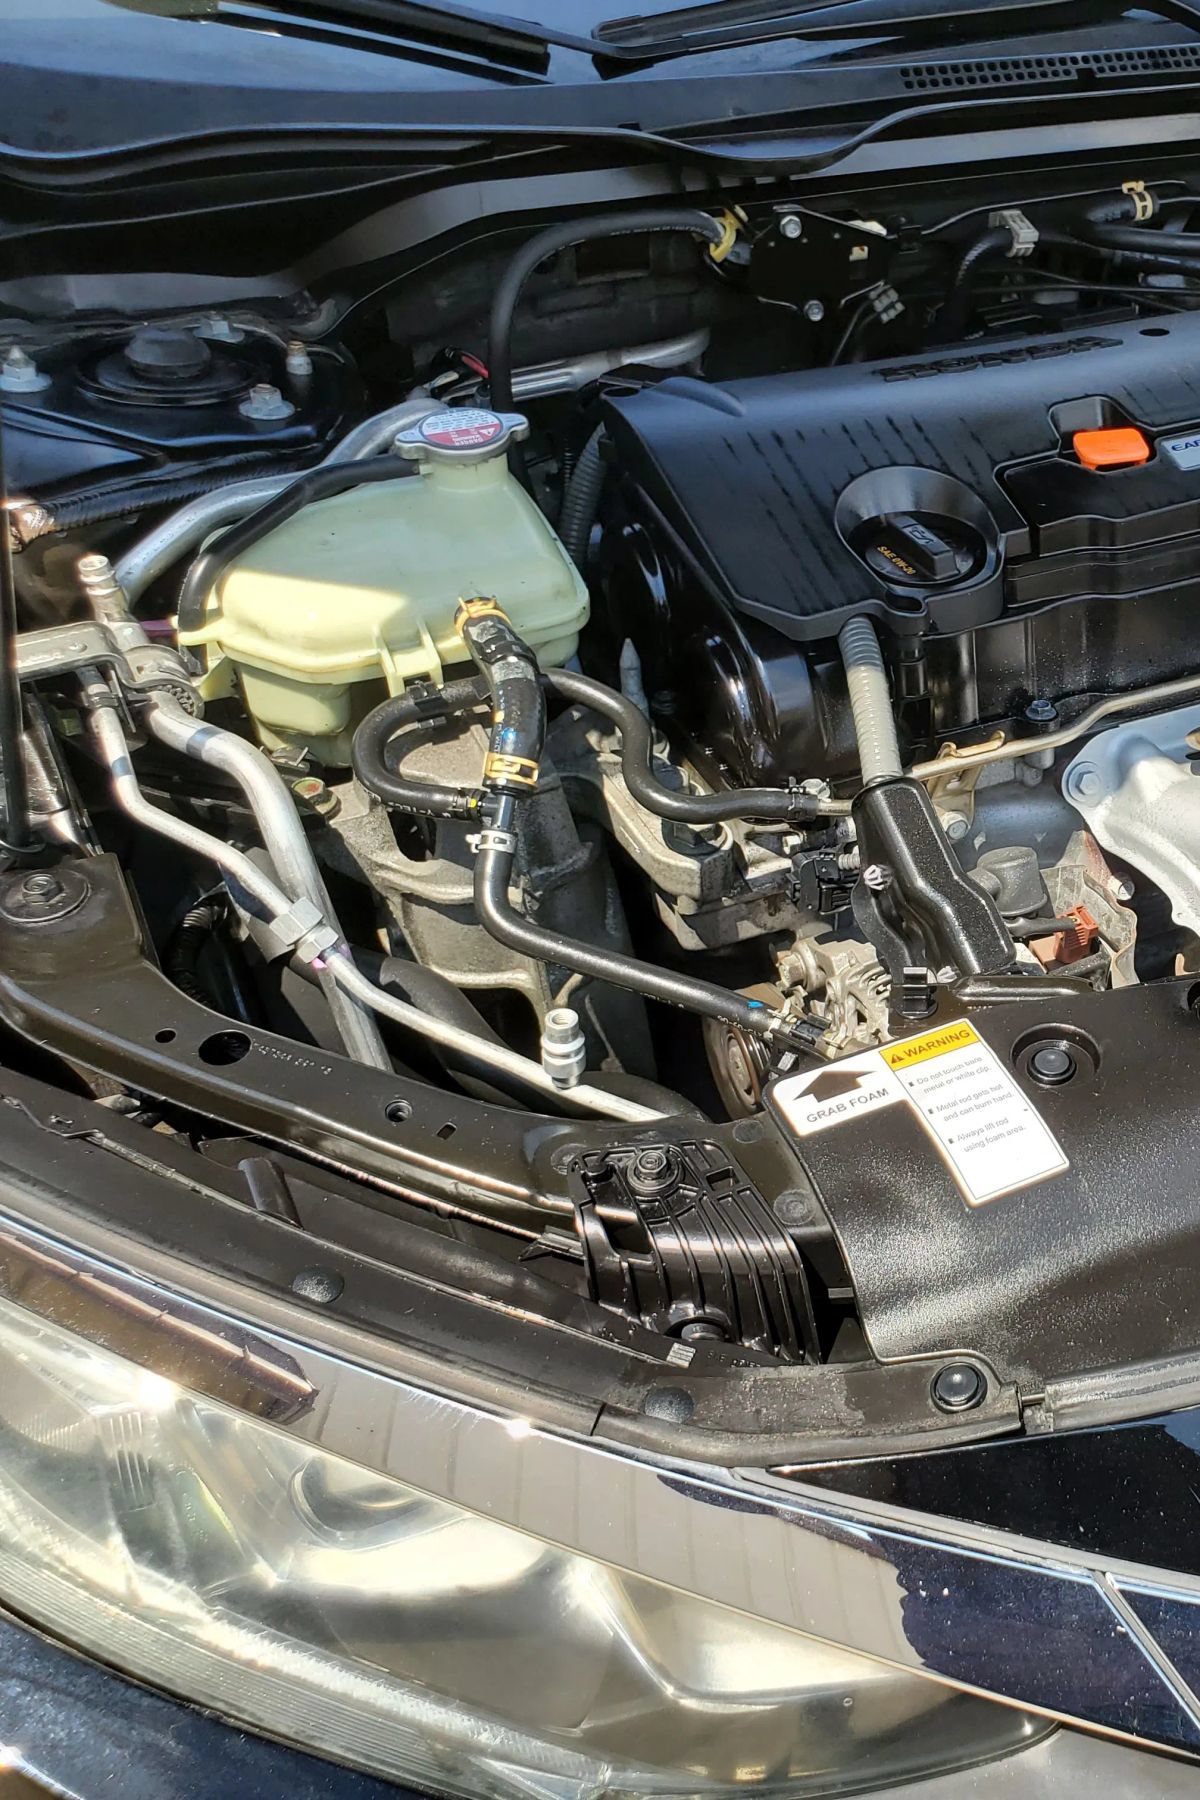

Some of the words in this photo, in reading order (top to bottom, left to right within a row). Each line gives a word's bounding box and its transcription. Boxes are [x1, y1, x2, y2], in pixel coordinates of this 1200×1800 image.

[876, 545, 897, 559] SAE
[891, 557, 917, 575] 0W-20
[903, 1029, 970, 1057] WARNING
[916, 1076, 929, 1085] Do
[929, 1070, 943, 1080] not
[942, 1062, 965, 1076] touch
[923, 1080, 945, 1095] metal
[954, 1069, 976, 1081] white
[806, 1103, 847, 1123] GRAB
[848, 1087, 889, 1108] FOAM
[936, 1099, 959, 1112] Metal
[958, 1093, 973, 1104] rod
[972, 1088, 990, 1100] gets
[989, 1082, 1004, 1093] hot
[943, 1110, 959, 1122] and
[959, 1105, 975, 1116] can
[973, 1098, 993, 1111] burn
[957, 1126, 985, 1142] Always
[984, 1121, 996, 1131] lift
[995, 1115, 1009, 1128] rod
[963, 1139, 986, 1153] using
[985, 1132, 1006, 1145] foam
